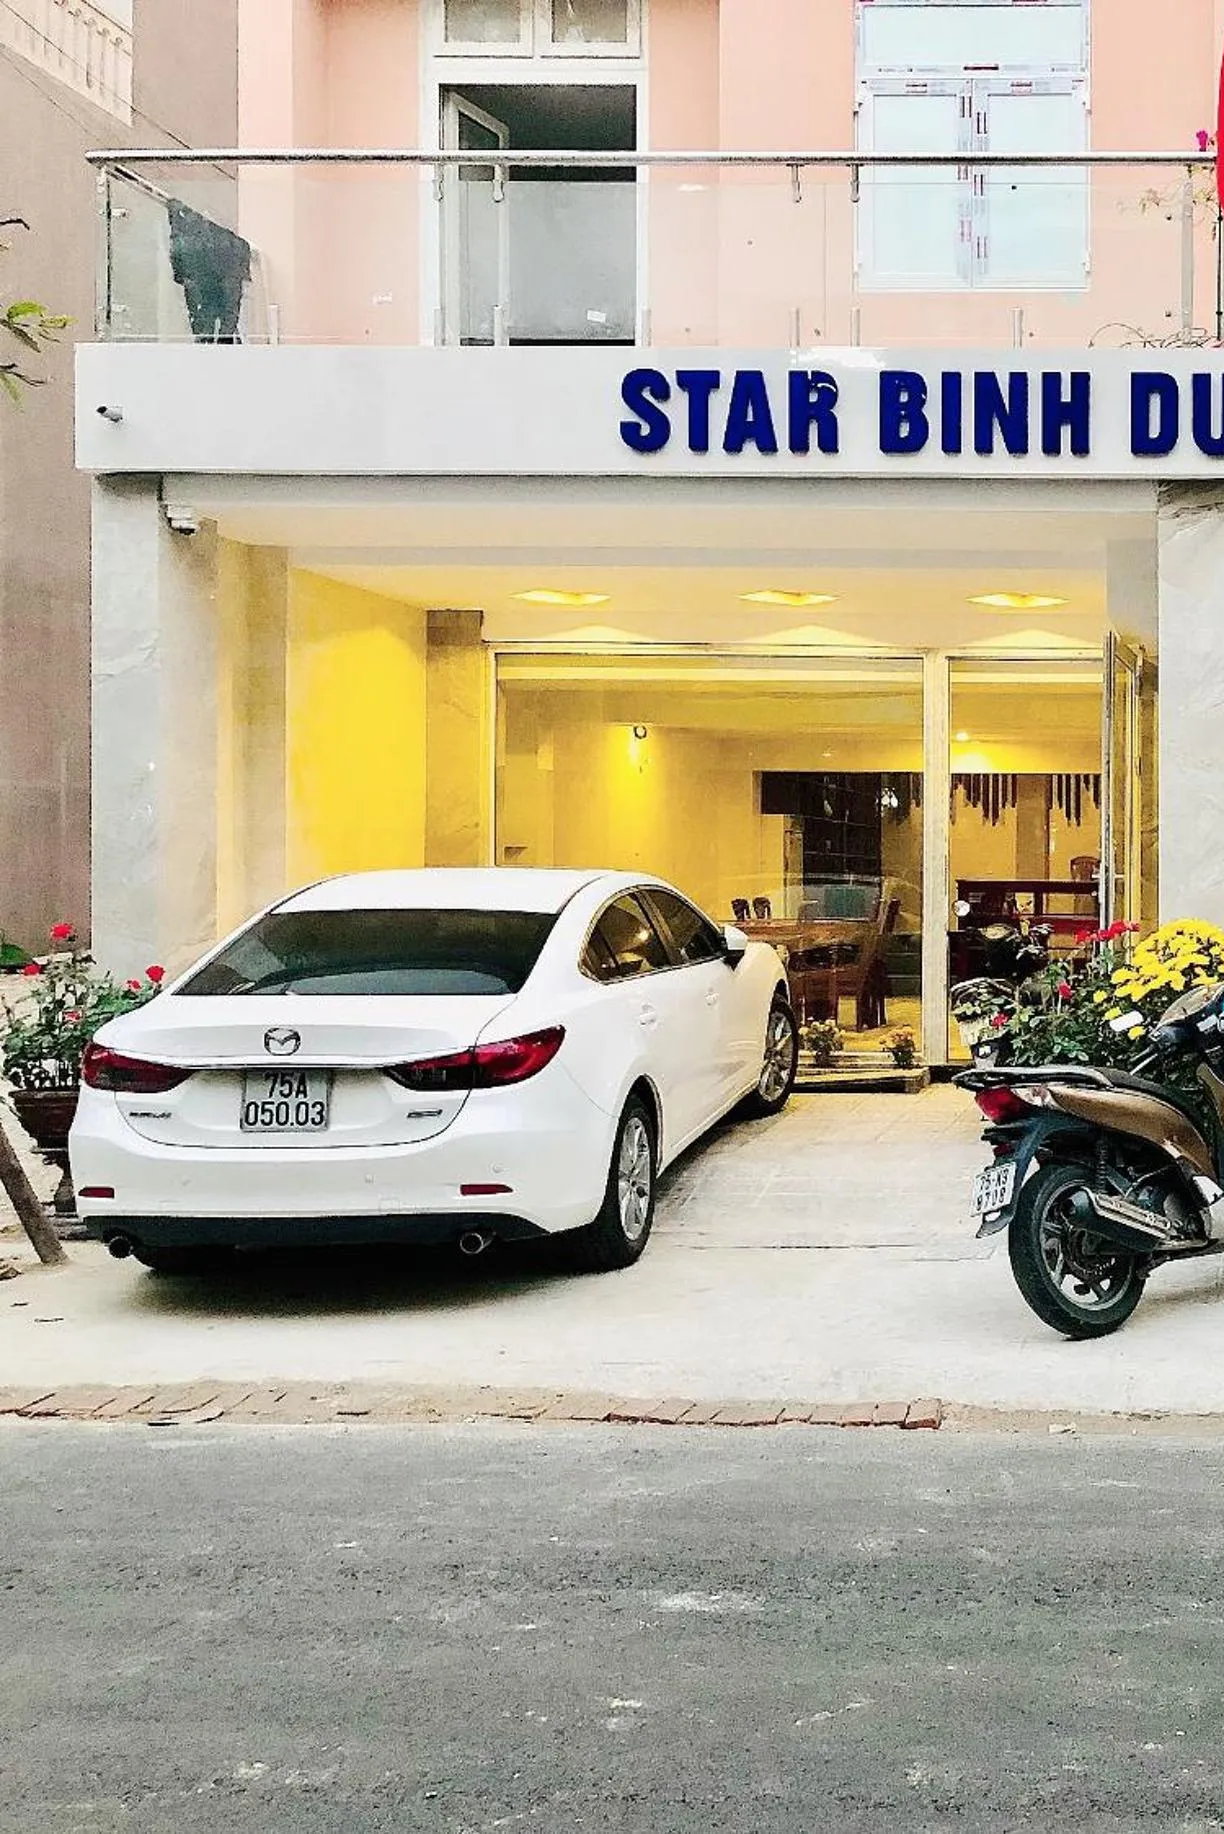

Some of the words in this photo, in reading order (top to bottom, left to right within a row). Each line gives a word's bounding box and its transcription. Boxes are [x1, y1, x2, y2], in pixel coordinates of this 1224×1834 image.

[620, 367, 839, 457] STAR
[879, 370, 1091, 458] BINH
[266, 1071, 308, 1099] 75A
[244, 1100, 326, 1127] 050.03
